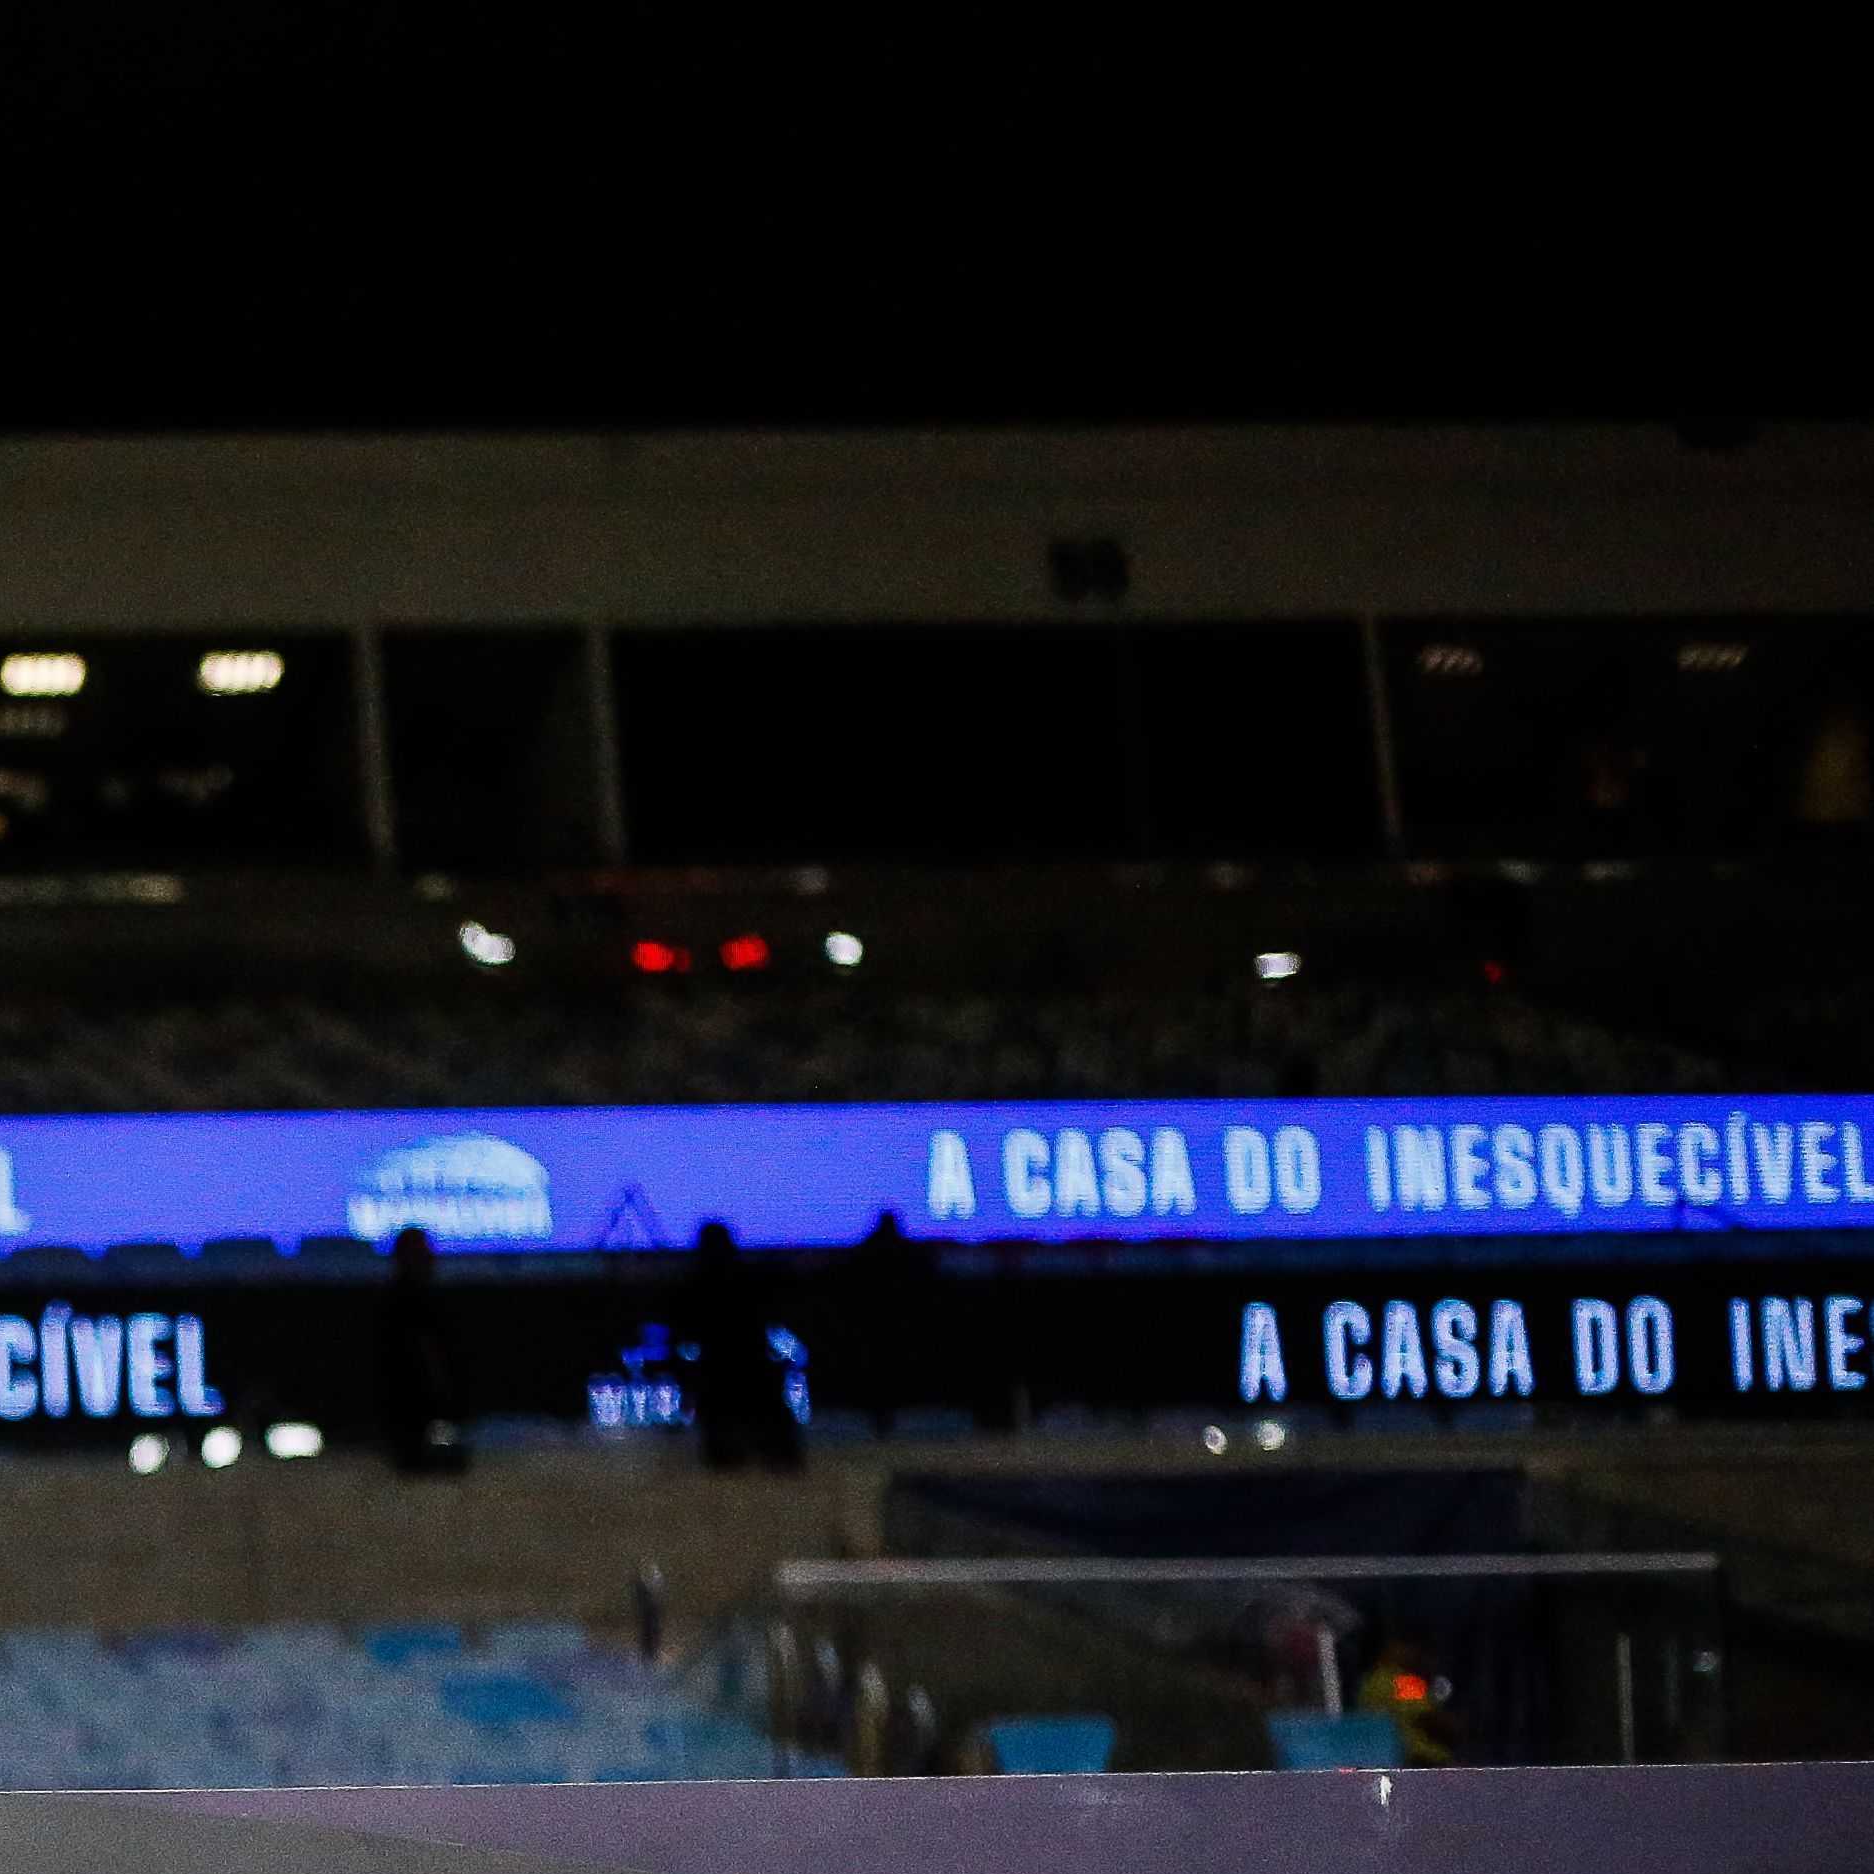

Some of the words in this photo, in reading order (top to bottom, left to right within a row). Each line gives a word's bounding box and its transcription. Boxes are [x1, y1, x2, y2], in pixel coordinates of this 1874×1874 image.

[926, 1129, 976, 1219] A
[1001, 1127, 1196, 1217] CASA
[1224, 1124, 1323, 1213] DO
[1364, 1110, 1874, 1217] INESQUECÍVEL
[1238, 1300, 1288, 1402] A
[1322, 1296, 1535, 1400] CASA
[1570, 1294, 1674, 1395] DO
[1728, 1294, 1874, 1392] INE
